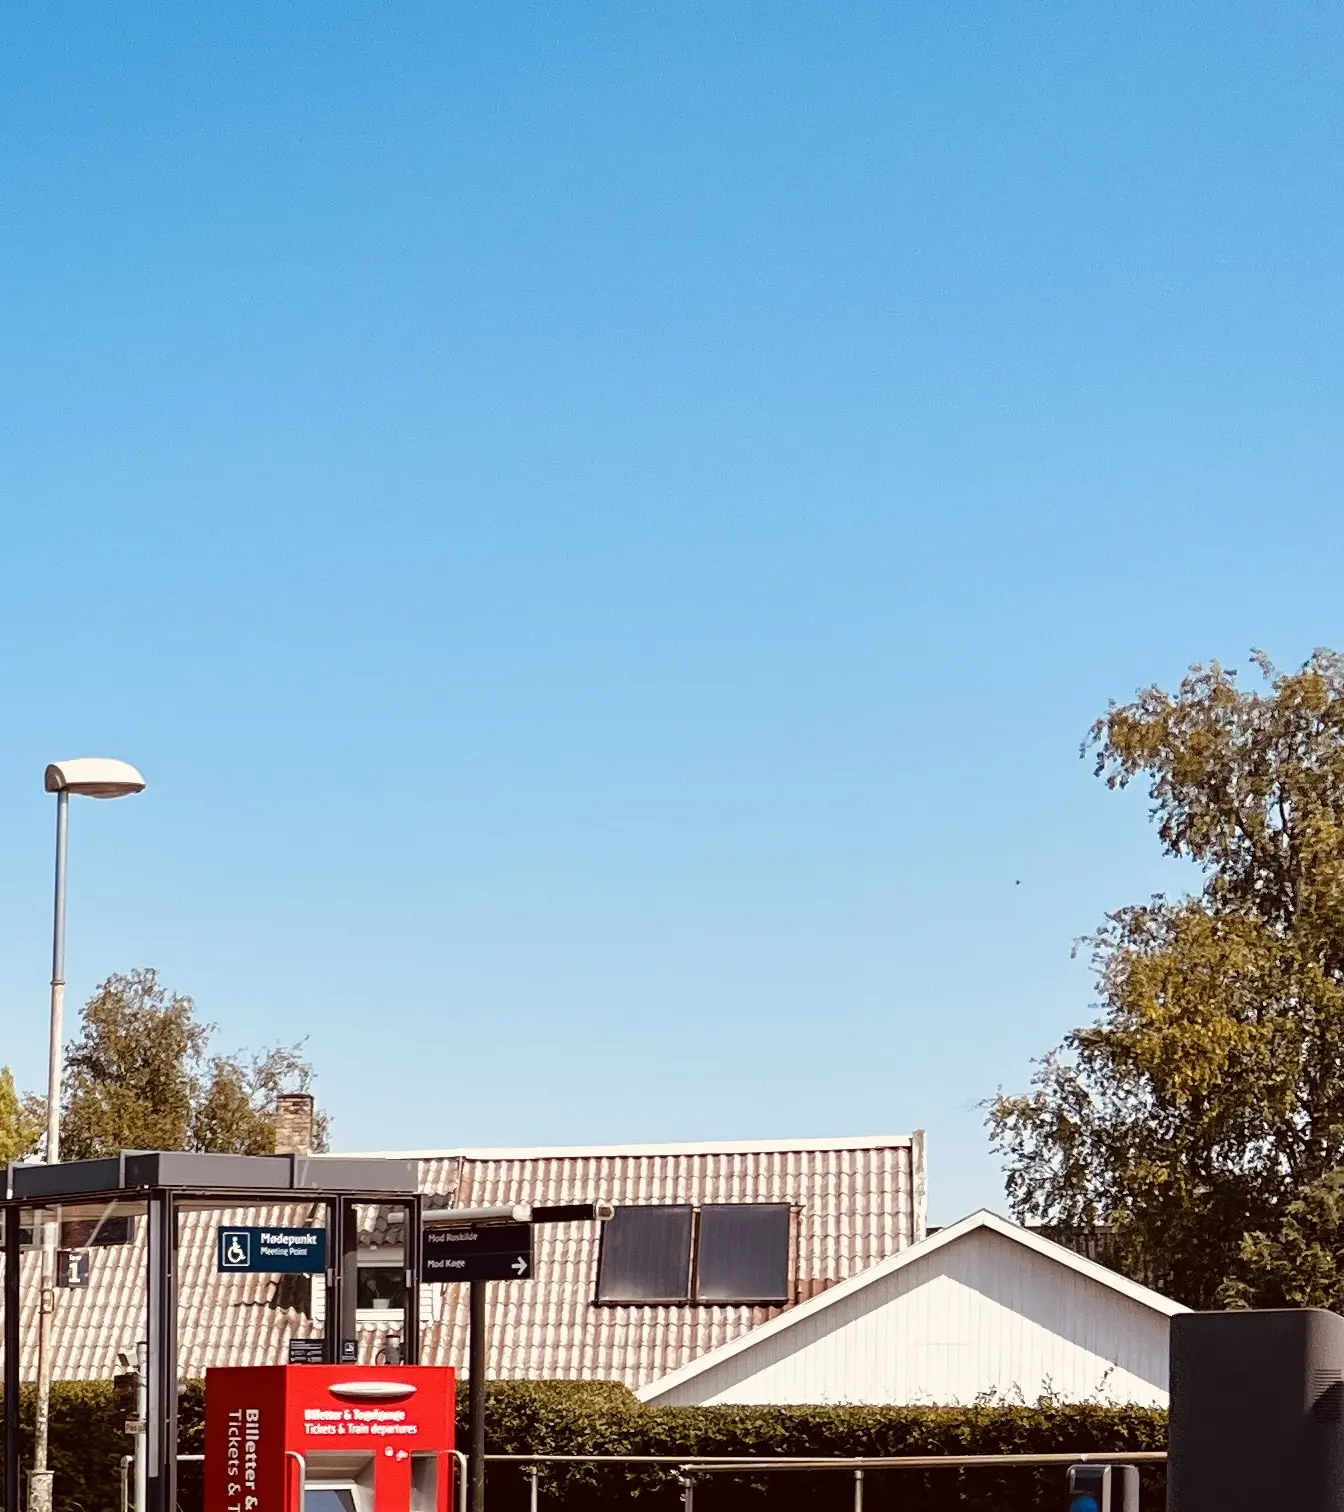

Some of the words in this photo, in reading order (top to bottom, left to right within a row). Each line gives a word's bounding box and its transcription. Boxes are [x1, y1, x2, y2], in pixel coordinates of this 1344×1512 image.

[260, 1233, 318, 1246] Mødepunkt
[428, 1234, 445, 1243] Mod
[446, 1232, 479, 1242] Roskilde
[260, 1246, 289, 1257] Meeting
[289, 1247, 309, 1256] Point
[427, 1260, 444, 1268] Mod
[68, 1262, 81, 1283] 1
[343, 1408, 353, 1421] &
[304, 1422, 337, 1434] Tickets
[337, 1422, 346, 1435] &
[347, 1422, 370, 1434] Train
[370, 1423, 418, 1436] departures
[227, 1408, 242, 1476] Tickets
[244, 1409, 260, 1490] Billetter
[227, 1482, 242, 1497] &
[244, 1495, 258, 1511] &
